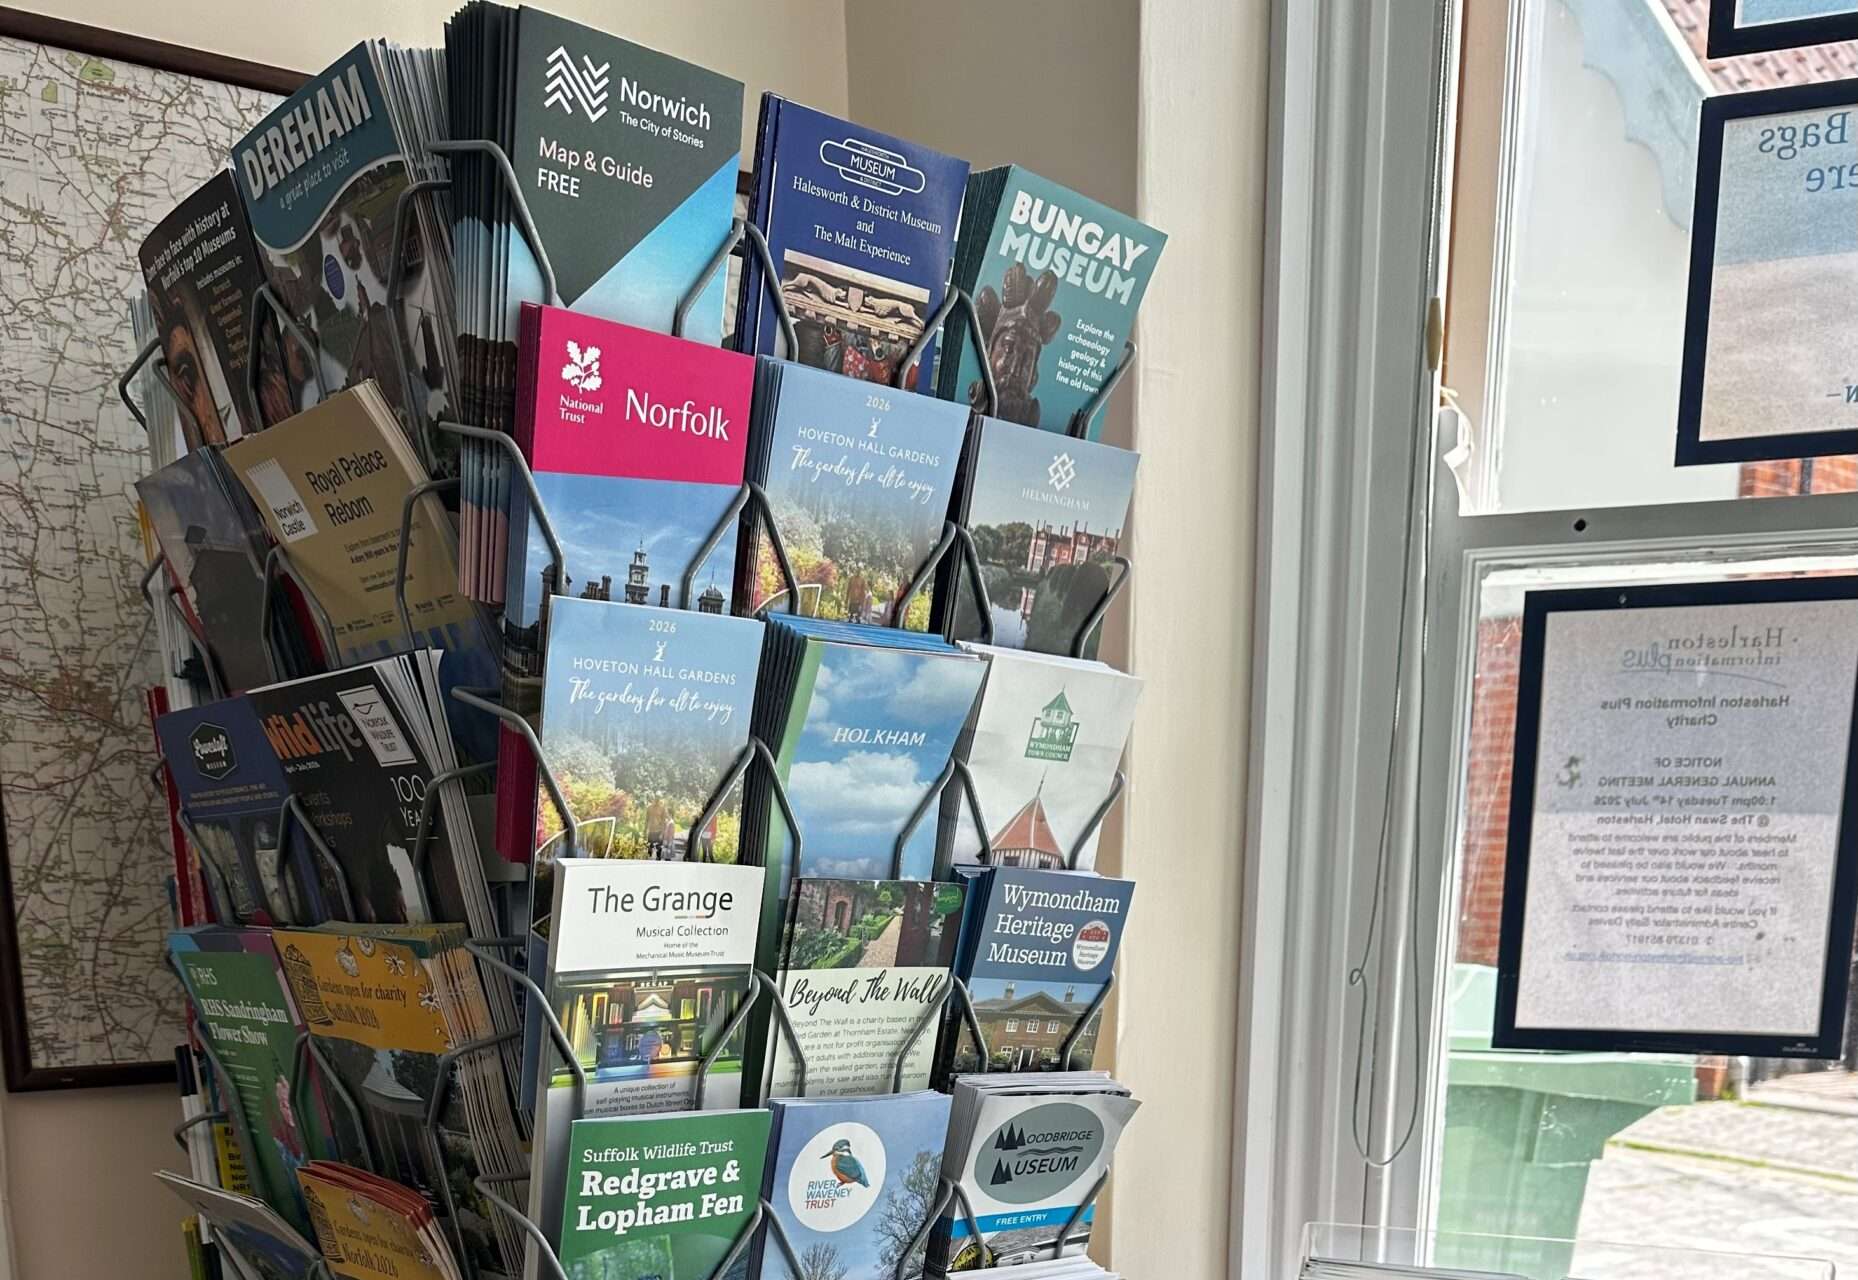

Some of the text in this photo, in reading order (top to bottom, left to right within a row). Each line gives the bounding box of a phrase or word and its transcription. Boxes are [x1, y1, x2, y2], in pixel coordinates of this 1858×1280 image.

[620, 76, 711, 130] Norwich
[241, 63, 373, 201] DEREHAM
[640, 119, 704, 149] City Stories
[540, 137, 653, 188] Map Guide
[850, 155, 896, 180] MUSEUM
[537, 168, 580, 198] FREE
[792, 175, 848, 205] Halesworth
[862, 197, 899, 223] District
[900, 209, 942, 234] Museum
[814, 224, 911, 266] The Experience
[1010, 189, 1149, 273] BUNGAY
[1000, 231, 1137, 305] MUSEUM
[1076, 318, 1102, 337] Explore
[559, 408, 586, 424] Trust
[560, 394, 603, 415] National
[625, 389, 730, 441] Norfolk
[866, 395, 891, 412] 2026
[799, 426, 940, 467] HOVETON HALL GARDENS
[305, 449, 388, 495] Royal Palace
[273, 500, 304, 520] Norwich
[324, 495, 375, 527] Reborn
[282, 518, 306, 536] Castle
[649, 619, 677, 633] 2026
[573, 657, 736, 686] HOVETON HALL GARDENS
[260, 701, 364, 763] Wildlife
[832, 727, 927, 747] HOLKHAM
[588, 886, 733, 919] The Grange
[1003, 884, 1120, 914] Wymondham
[636, 925, 729, 938] Musical Collection
[994, 914, 1074, 944] Heritage
[987, 942, 1068, 967] Museum
[375, 983, 407, 1008] charity
[788, 969, 943, 1016] Beyond The Wall
[221, 999, 288, 1024] Sandringham
[209, 1022, 268, 1046] Flower Show
[583, 1140, 734, 1163] Suffolk Wildlife Trust
[580, 1165, 718, 1199] Redgrave
[806, 1188, 852, 1200] WAVENEY
[808, 1179, 836, 1190] RIVER
[576, 1193, 744, 1235] Lopham Fen
[805, 1198, 836, 1209] TRUST
[996, 1213, 1048, 1226] FREE ENTRY
